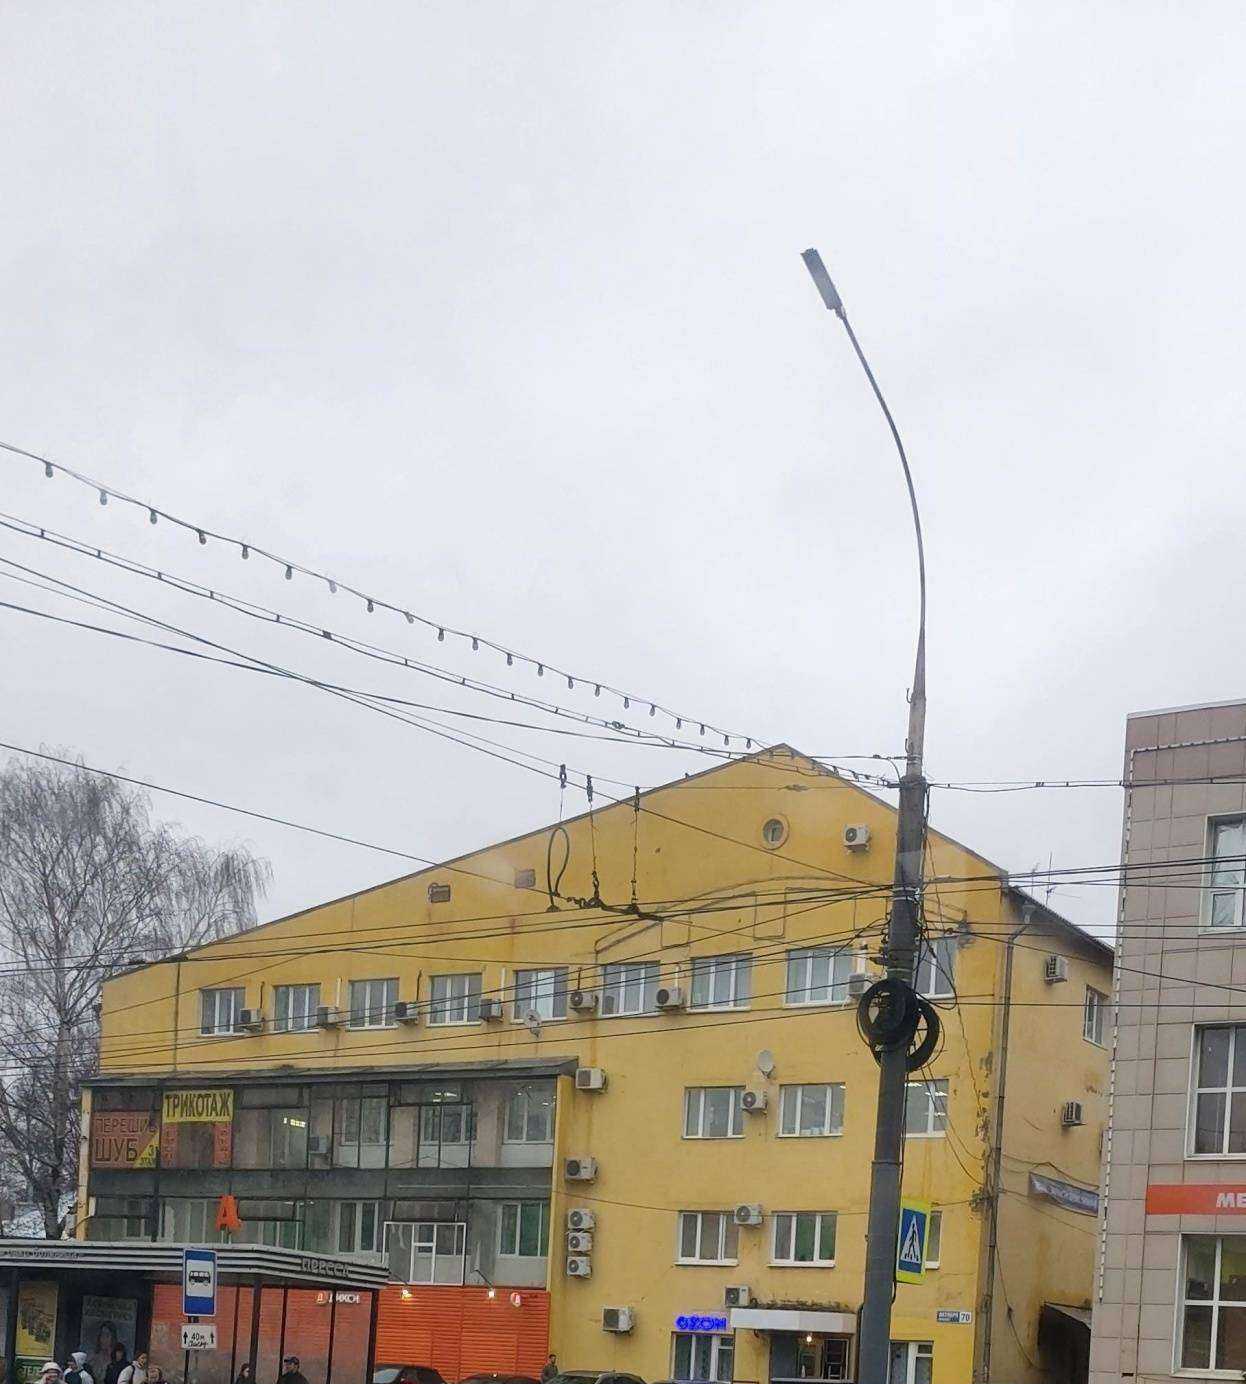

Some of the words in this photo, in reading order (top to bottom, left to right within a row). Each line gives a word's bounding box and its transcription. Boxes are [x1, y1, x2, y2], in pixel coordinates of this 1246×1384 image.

[164, 1093, 232, 1118] ТРИКОТАЖ
[95, 1137, 138, 1162] ШУБ
[675, 1315, 727, 1330] OZON
[960, 1312, 970, 1322] 70
